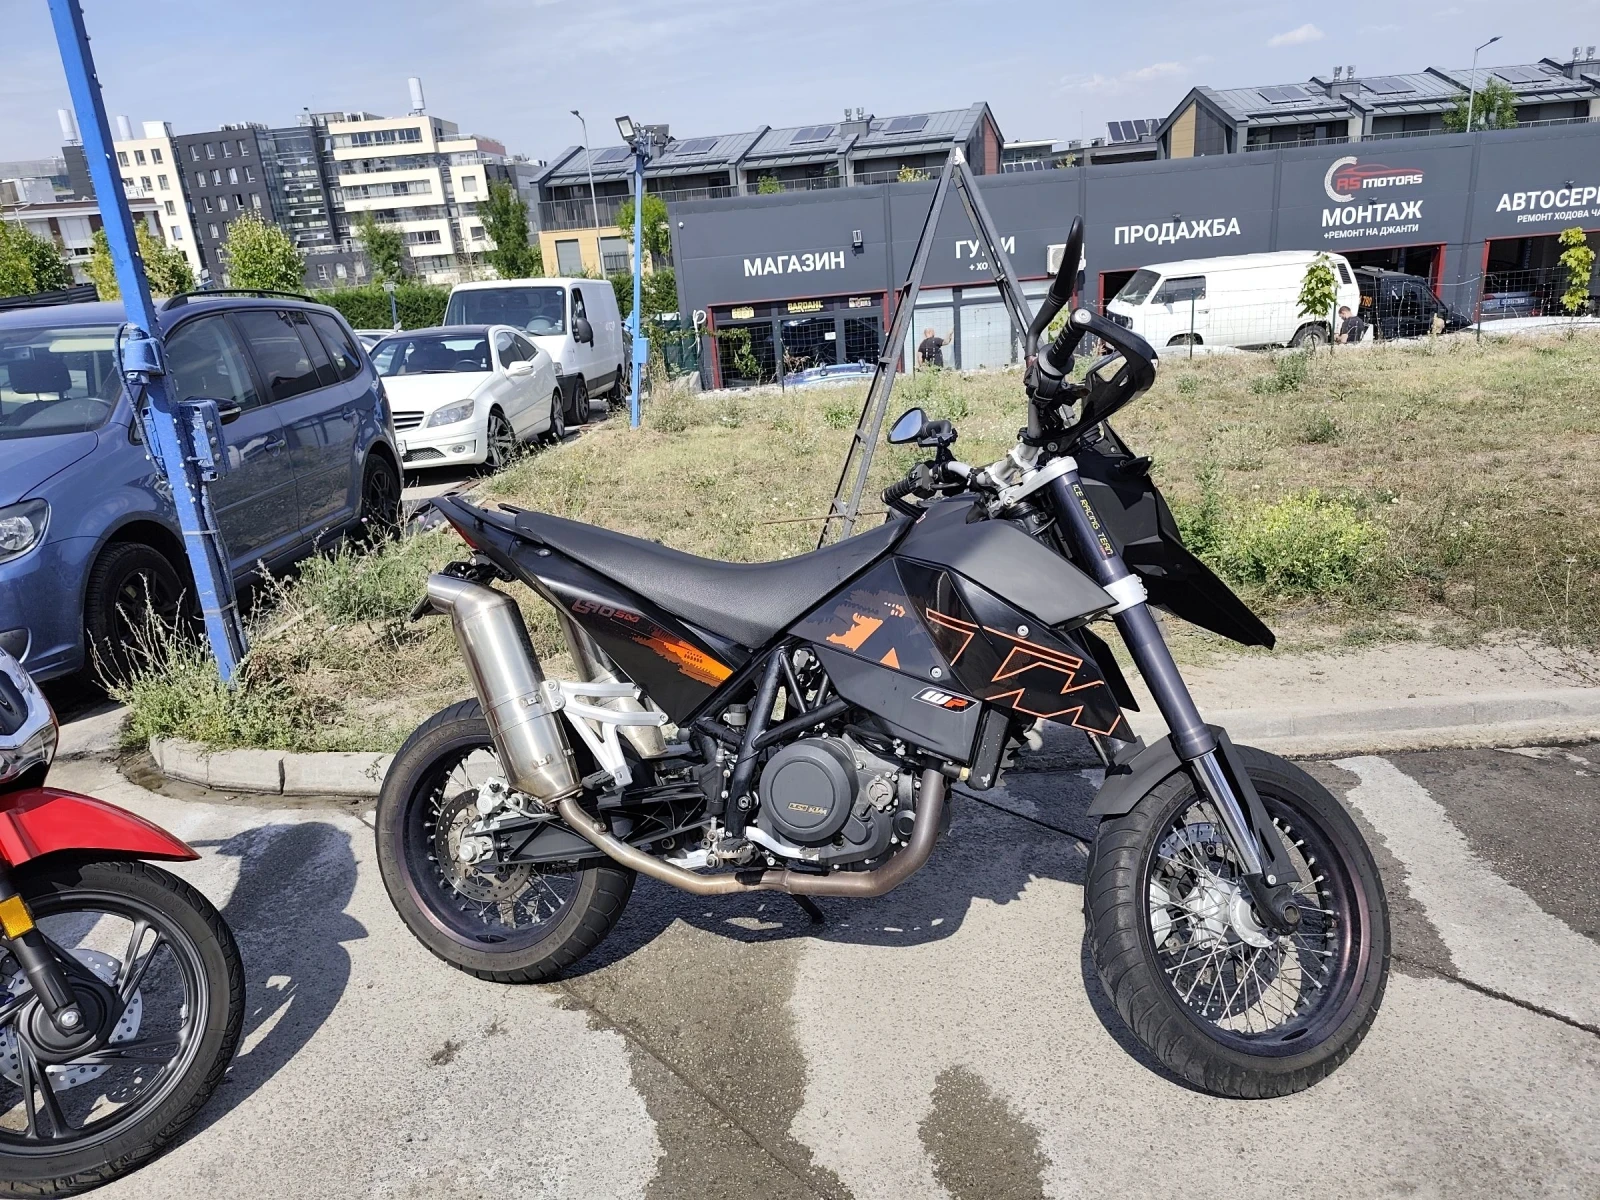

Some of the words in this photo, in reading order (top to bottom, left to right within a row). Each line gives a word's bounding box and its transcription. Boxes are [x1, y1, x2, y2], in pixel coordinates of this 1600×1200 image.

[1362, 174, 1423, 189] MOTORS
[1495, 186, 1600, 212] АВТОСЕР
[1321, 200, 1424, 227] МОНТАЖ
[1517, 212, 1553, 223] РЕМОНТ
[1553, 209, 1589, 221] ХОДОВА
[1114, 217, 1241, 245] ПРОДАЖБА
[1323, 229, 1364, 239] +РЕМОНТ
[1365, 227, 1379, 236] НА
[1379, 223, 1419, 236] ДЖАНТИ
[955, 235, 1016, 259] ГУИ
[743, 250, 846, 277] МАГАЗИН
[787, 300, 824, 312] BARDAHL
[1072, 484, 1084, 497] ICE
[1080, 499, 1101, 530] RACING
[144, 1067, 203, 1135] MICHELIN
